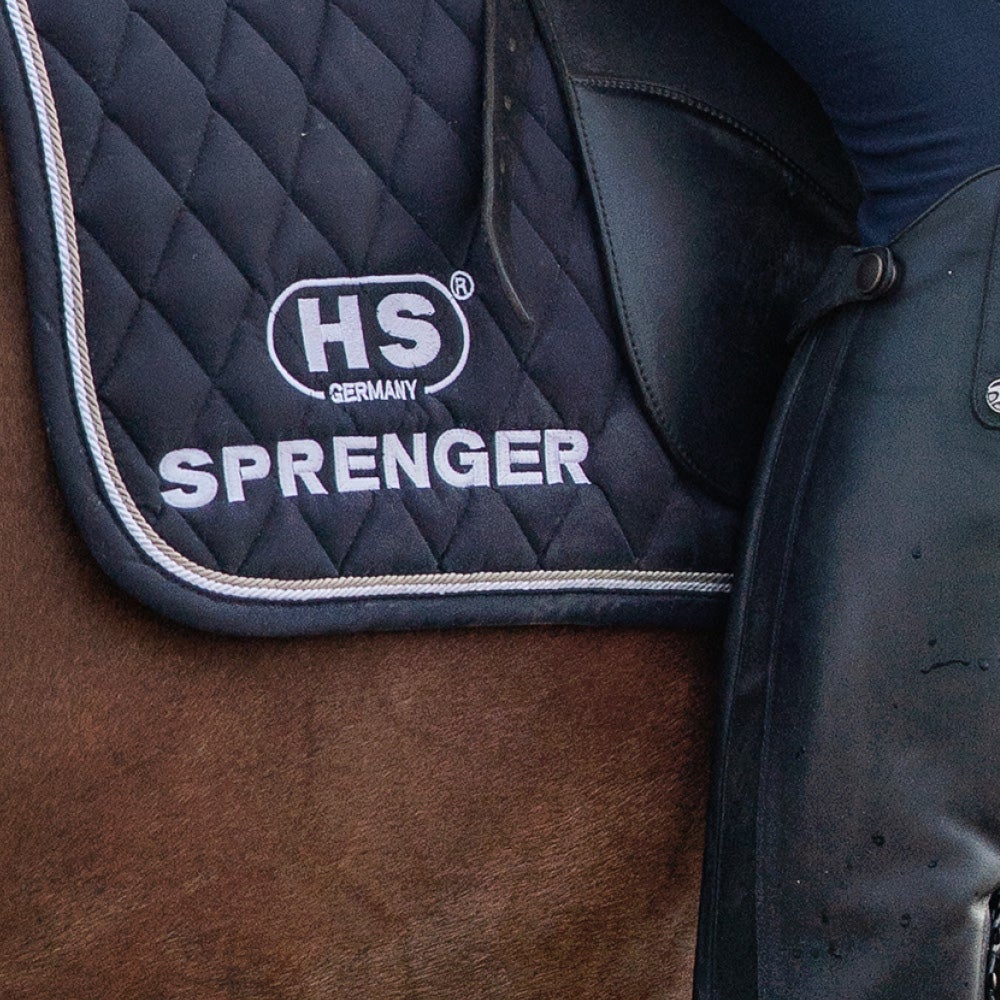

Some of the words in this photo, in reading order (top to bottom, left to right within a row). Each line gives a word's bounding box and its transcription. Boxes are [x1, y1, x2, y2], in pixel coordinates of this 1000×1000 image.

[297, 292, 442, 373] HS
[329, 378, 418, 404] GERMANY
[158, 427, 592, 510] SPRENGER
